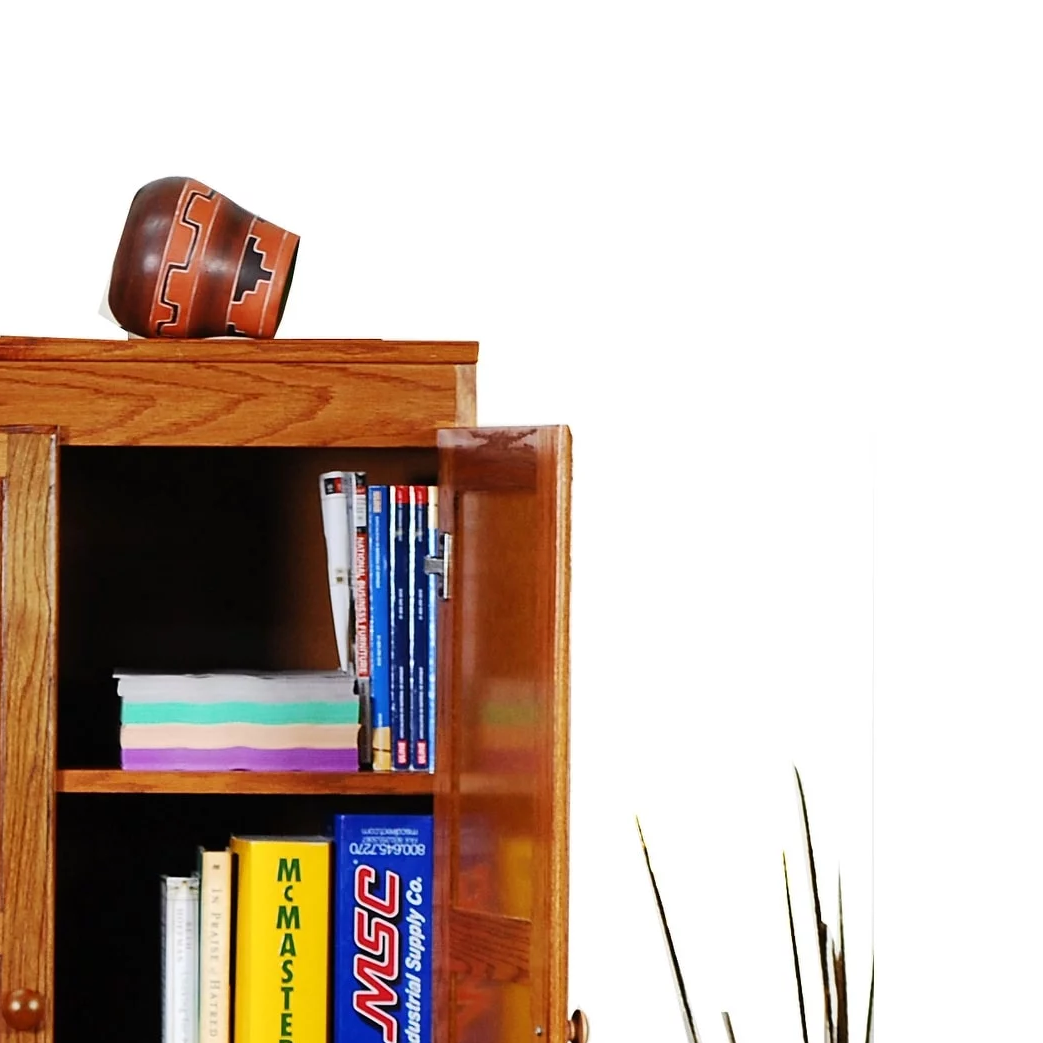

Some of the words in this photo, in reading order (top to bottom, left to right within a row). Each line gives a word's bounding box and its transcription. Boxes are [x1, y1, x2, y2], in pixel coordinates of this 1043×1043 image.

[356, 536, 366, 578] NATIONAL
[356, 580, 367, 623] BUSINESS
[357, 625, 368, 674] FURNITURE
[349, 842, 426, 856] 800.645.7270
[406, 877, 423, 905] Co.
[209, 912, 221, 962] PRAISE
[405, 908, 426, 972] Supply
[208, 979, 221, 1038] HATRED
